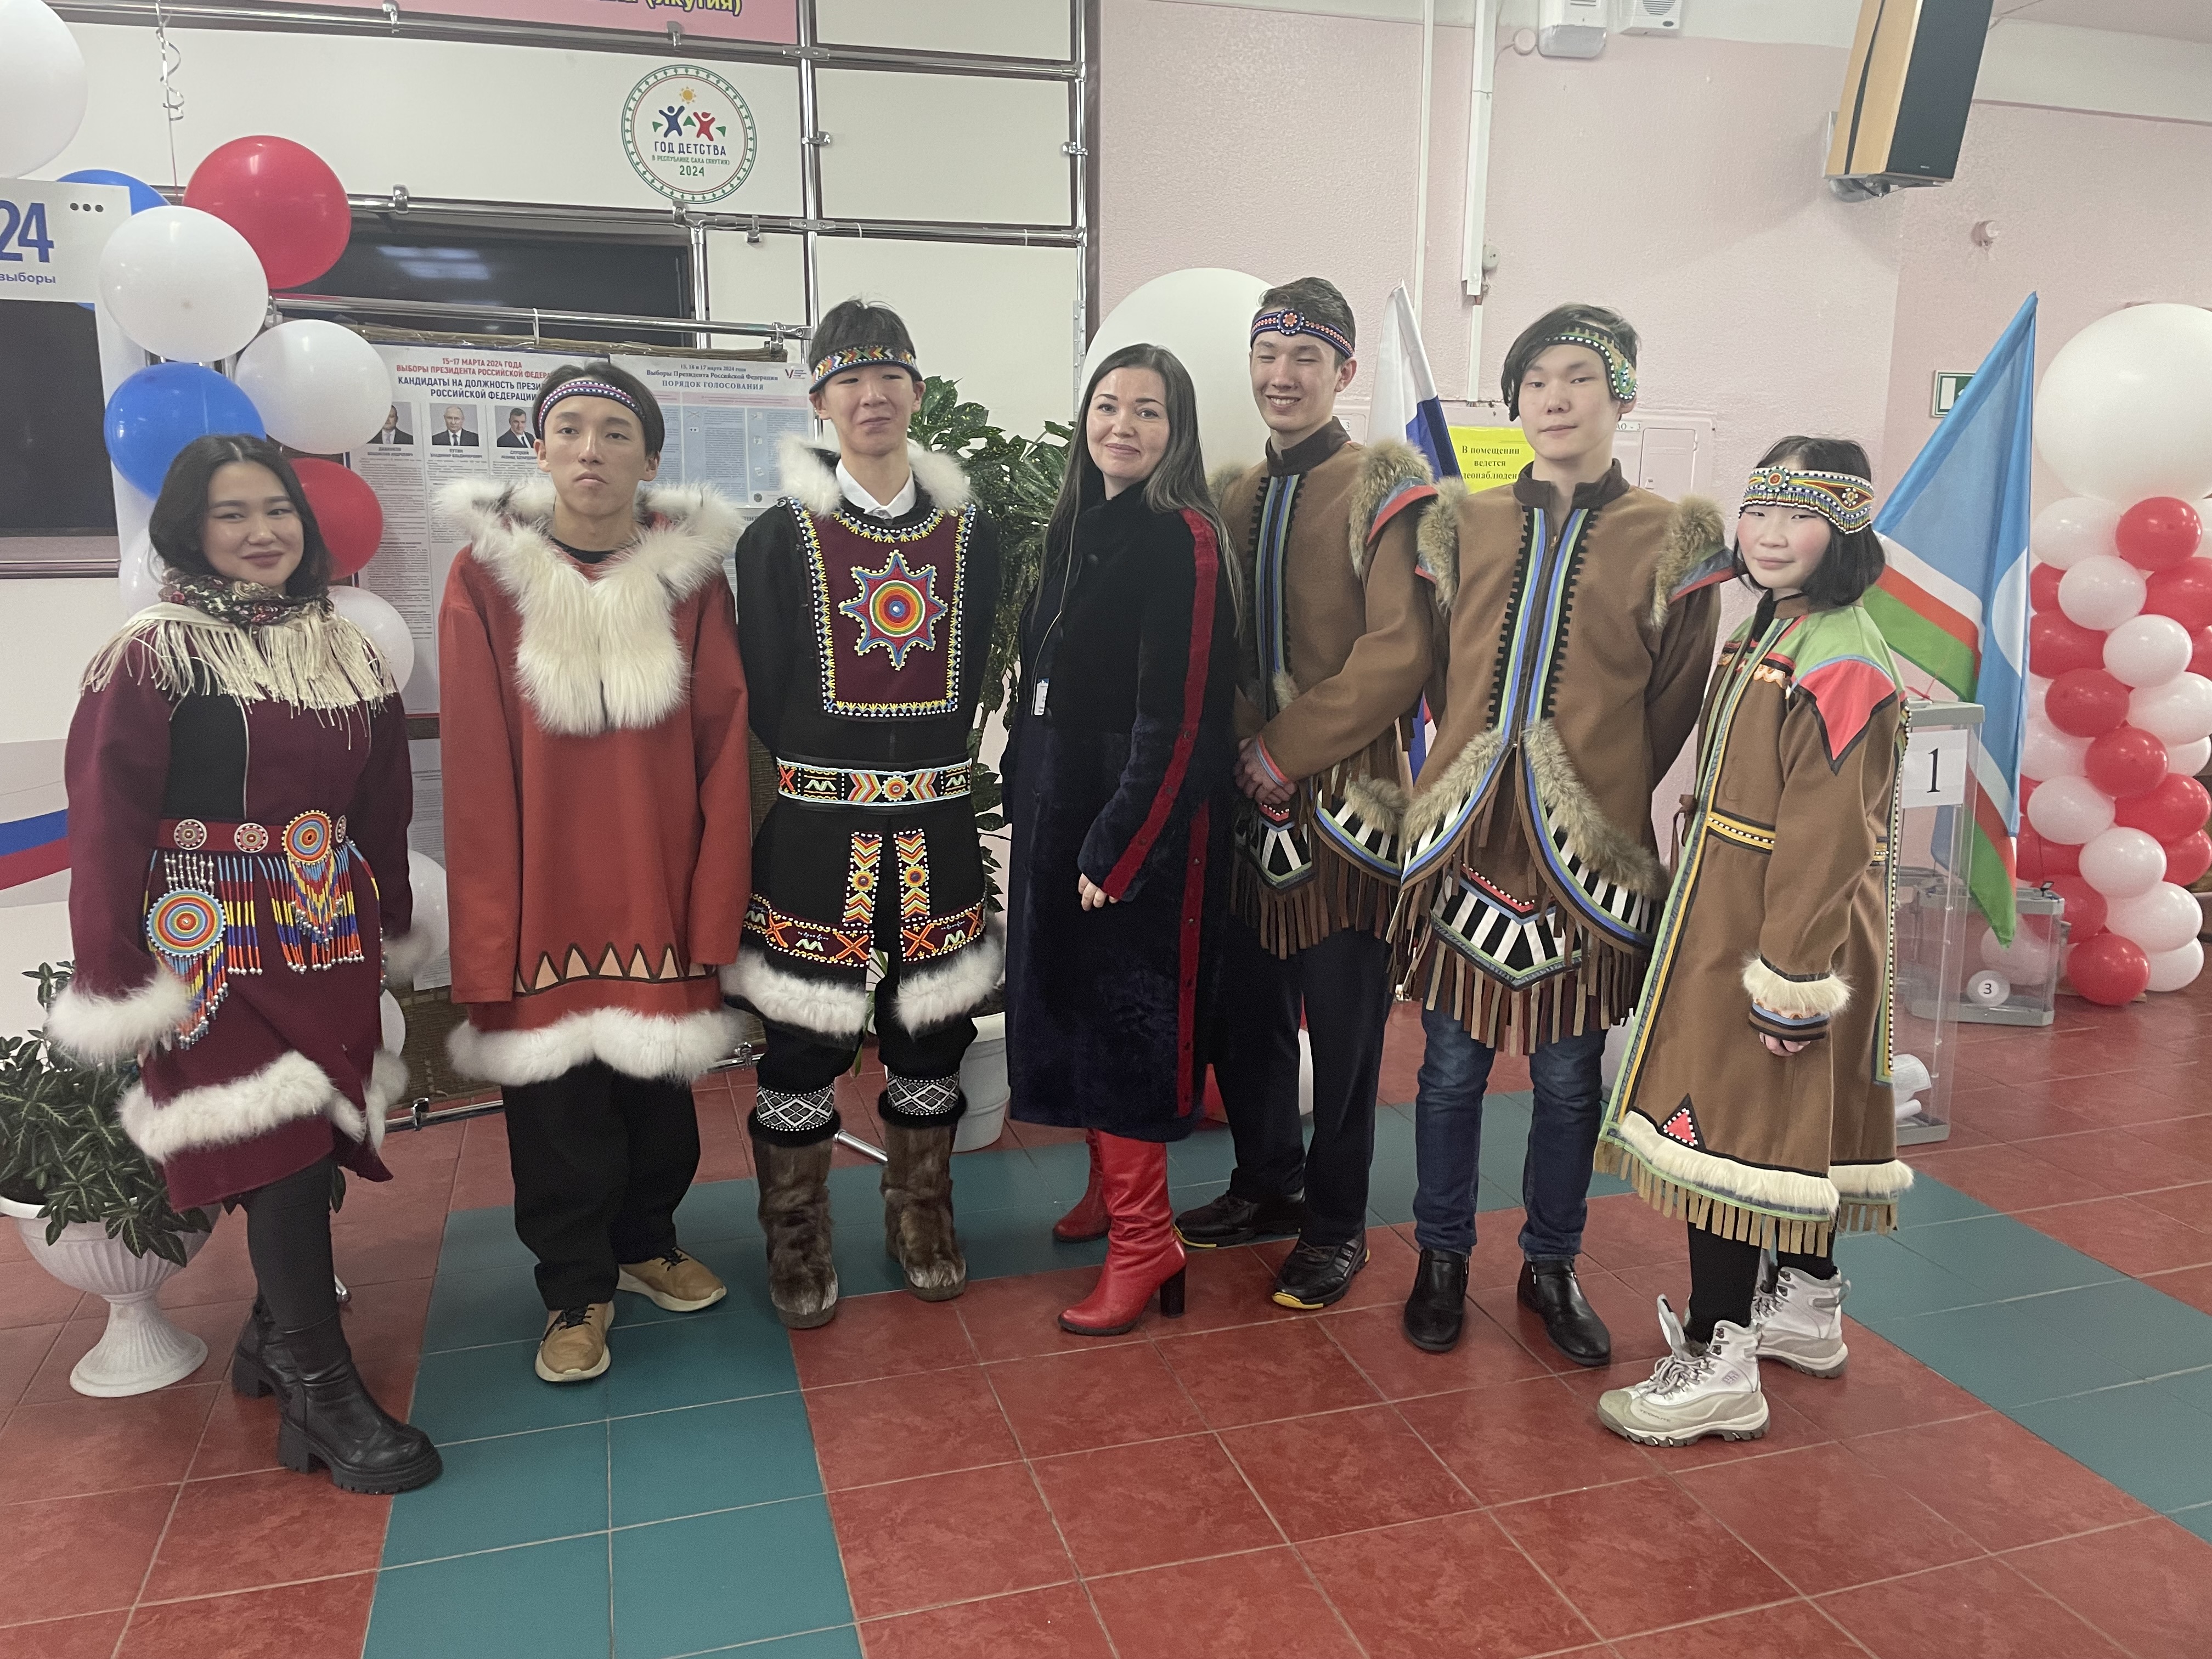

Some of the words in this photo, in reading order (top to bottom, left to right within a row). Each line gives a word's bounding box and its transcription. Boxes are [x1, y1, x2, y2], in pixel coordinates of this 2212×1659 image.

[654, 141, 675, 154] ГОД
[679, 143, 726, 156] ДЕТСТВА
[680, 165, 705, 177] 2024
[0, 200, 54, 263] 24
[0, 272, 56, 285] выборы
[462, 358, 486, 366] МАРТА
[396, 364, 428, 373] ВЫБОРЫ
[431, 366, 476, 375] ПРЕЗИДЕНТА
[478, 368, 523, 377] РОССИЙСКОЙ
[524, 371, 549, 379] ФЕДЕР
[398, 376, 450, 386] КАНДИДАТЫ
[465, 379, 515, 389] ДОЛЖНОСТЬ
[703, 382, 764, 390] ГОЛОСОВАНИЯ
[431, 388, 486, 399] РОССИЙСКОЙ
[1462, 445, 1468, 454] В
[1927, 748, 1940, 793] 1
[1983, 983, 1992, 994] 3
